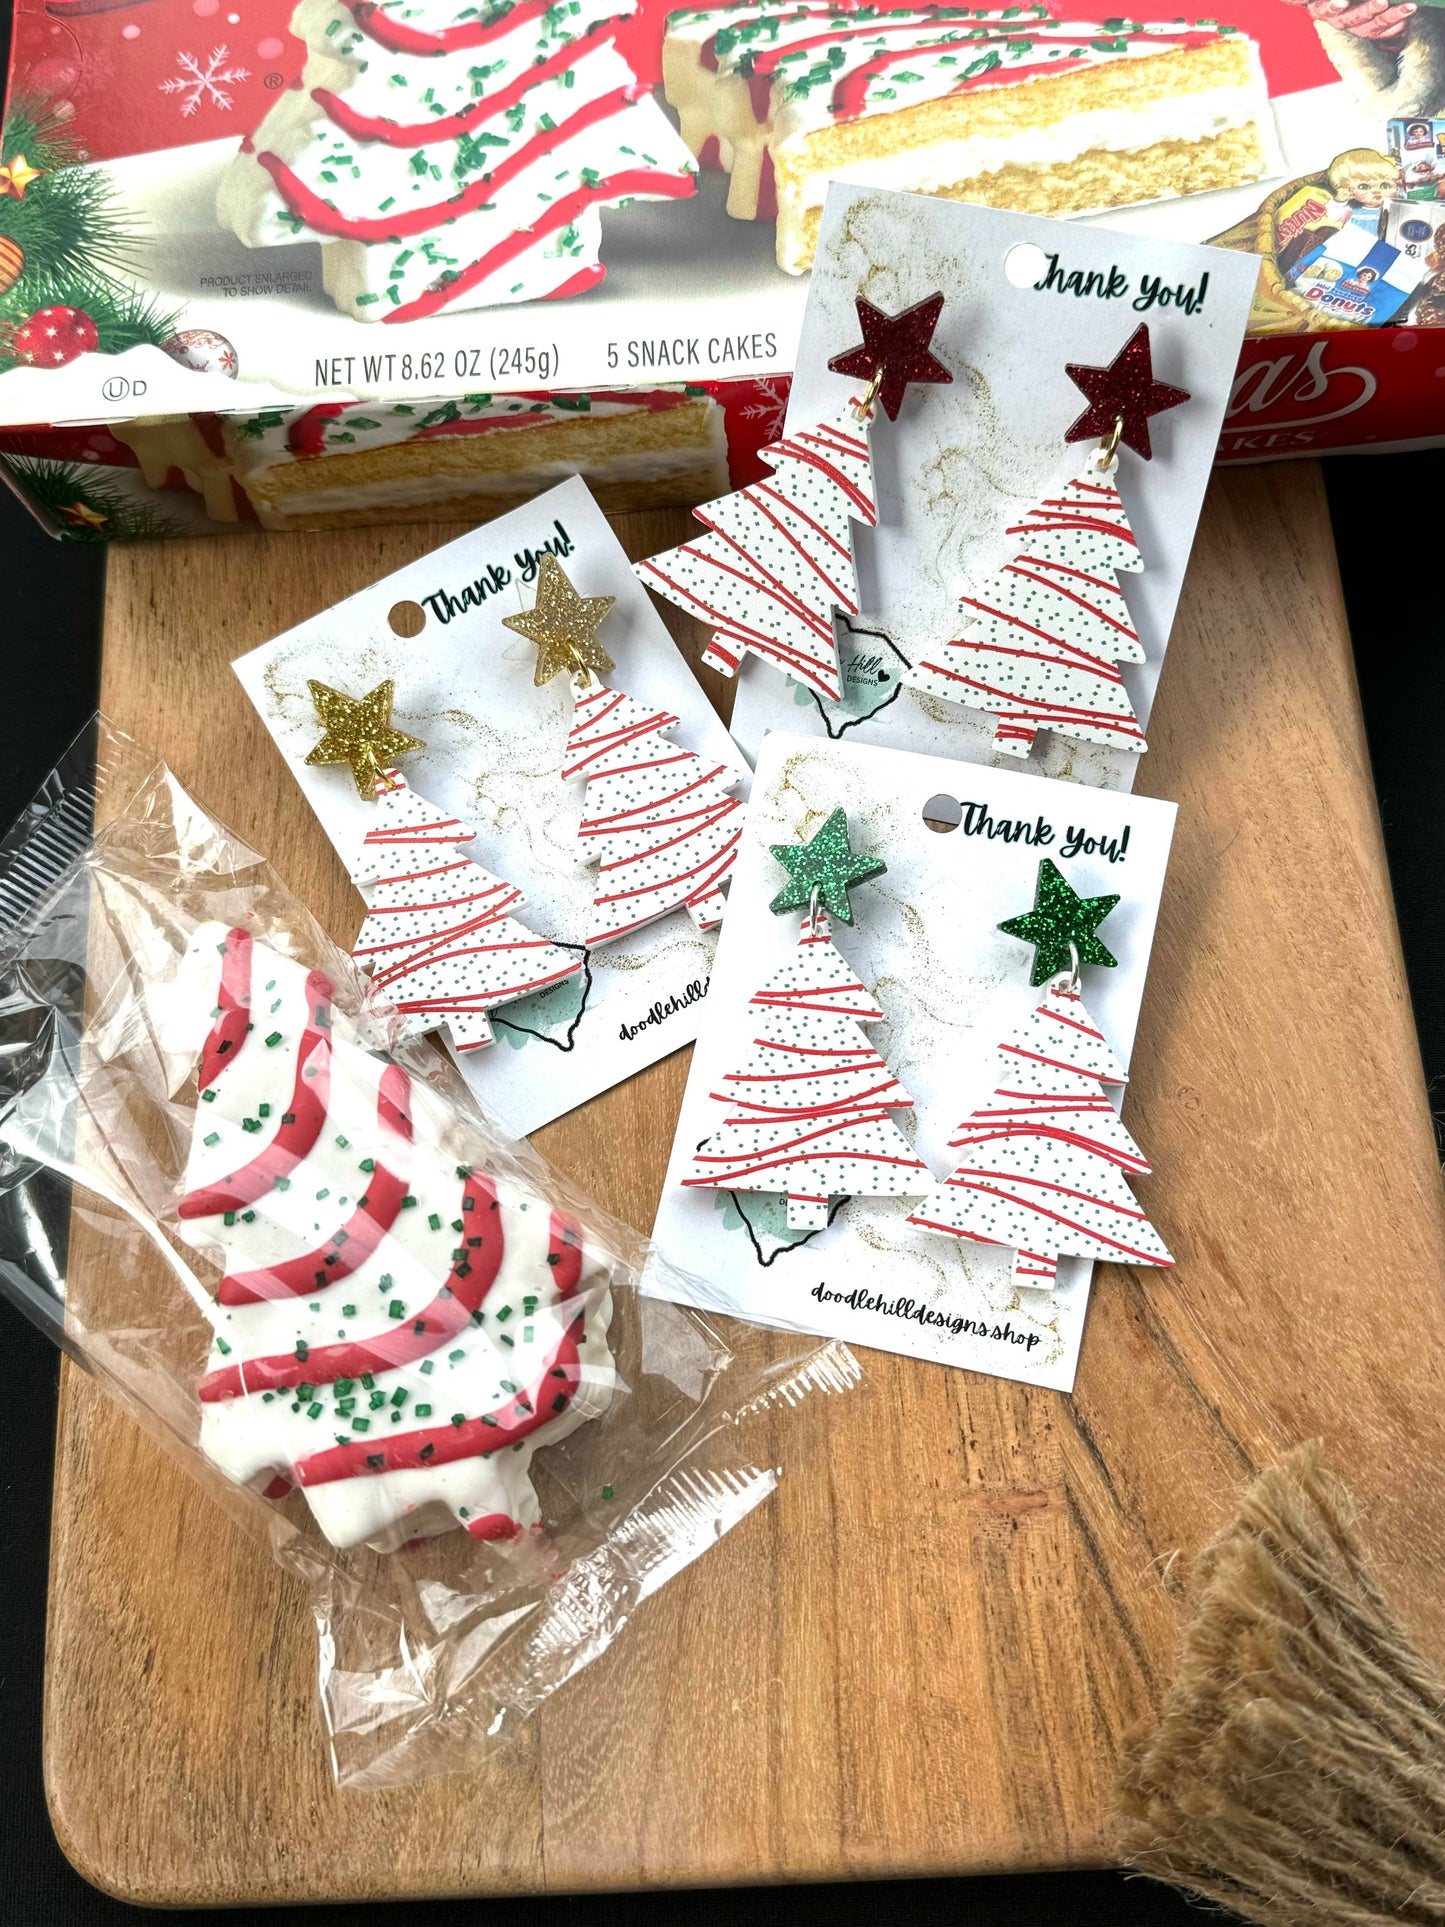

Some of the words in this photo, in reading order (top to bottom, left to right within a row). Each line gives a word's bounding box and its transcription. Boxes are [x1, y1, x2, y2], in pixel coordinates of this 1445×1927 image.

[200, 274, 253, 288] PRODUCT
[255, 270, 313, 284] ENLARGED
[222, 286, 238, 298] TO
[240, 285, 273, 297] SHOW
[276, 282, 312, 294] DETAIL
[1304, 287, 1376, 317] Donuts
[607, 342, 619, 369] 5
[627, 338, 700, 368] SNACK
[708, 332, 777, 364] CAKES
[315, 356, 356, 387] NET
[363, 354, 397, 383] WT
[401, 351, 445, 380] 8.62
[454, 349, 481, 377] OZ
[490, 343, 559, 381] (245g)
[1217, 431, 1316, 451] KES
[421, 564, 511, 625] Thank
[847, 654, 883, 675] Hill
[846, 674, 878, 688] DESIGNS
[960, 801, 1056, 847] Thank
[539, 979, 569, 999] DESIGNS
